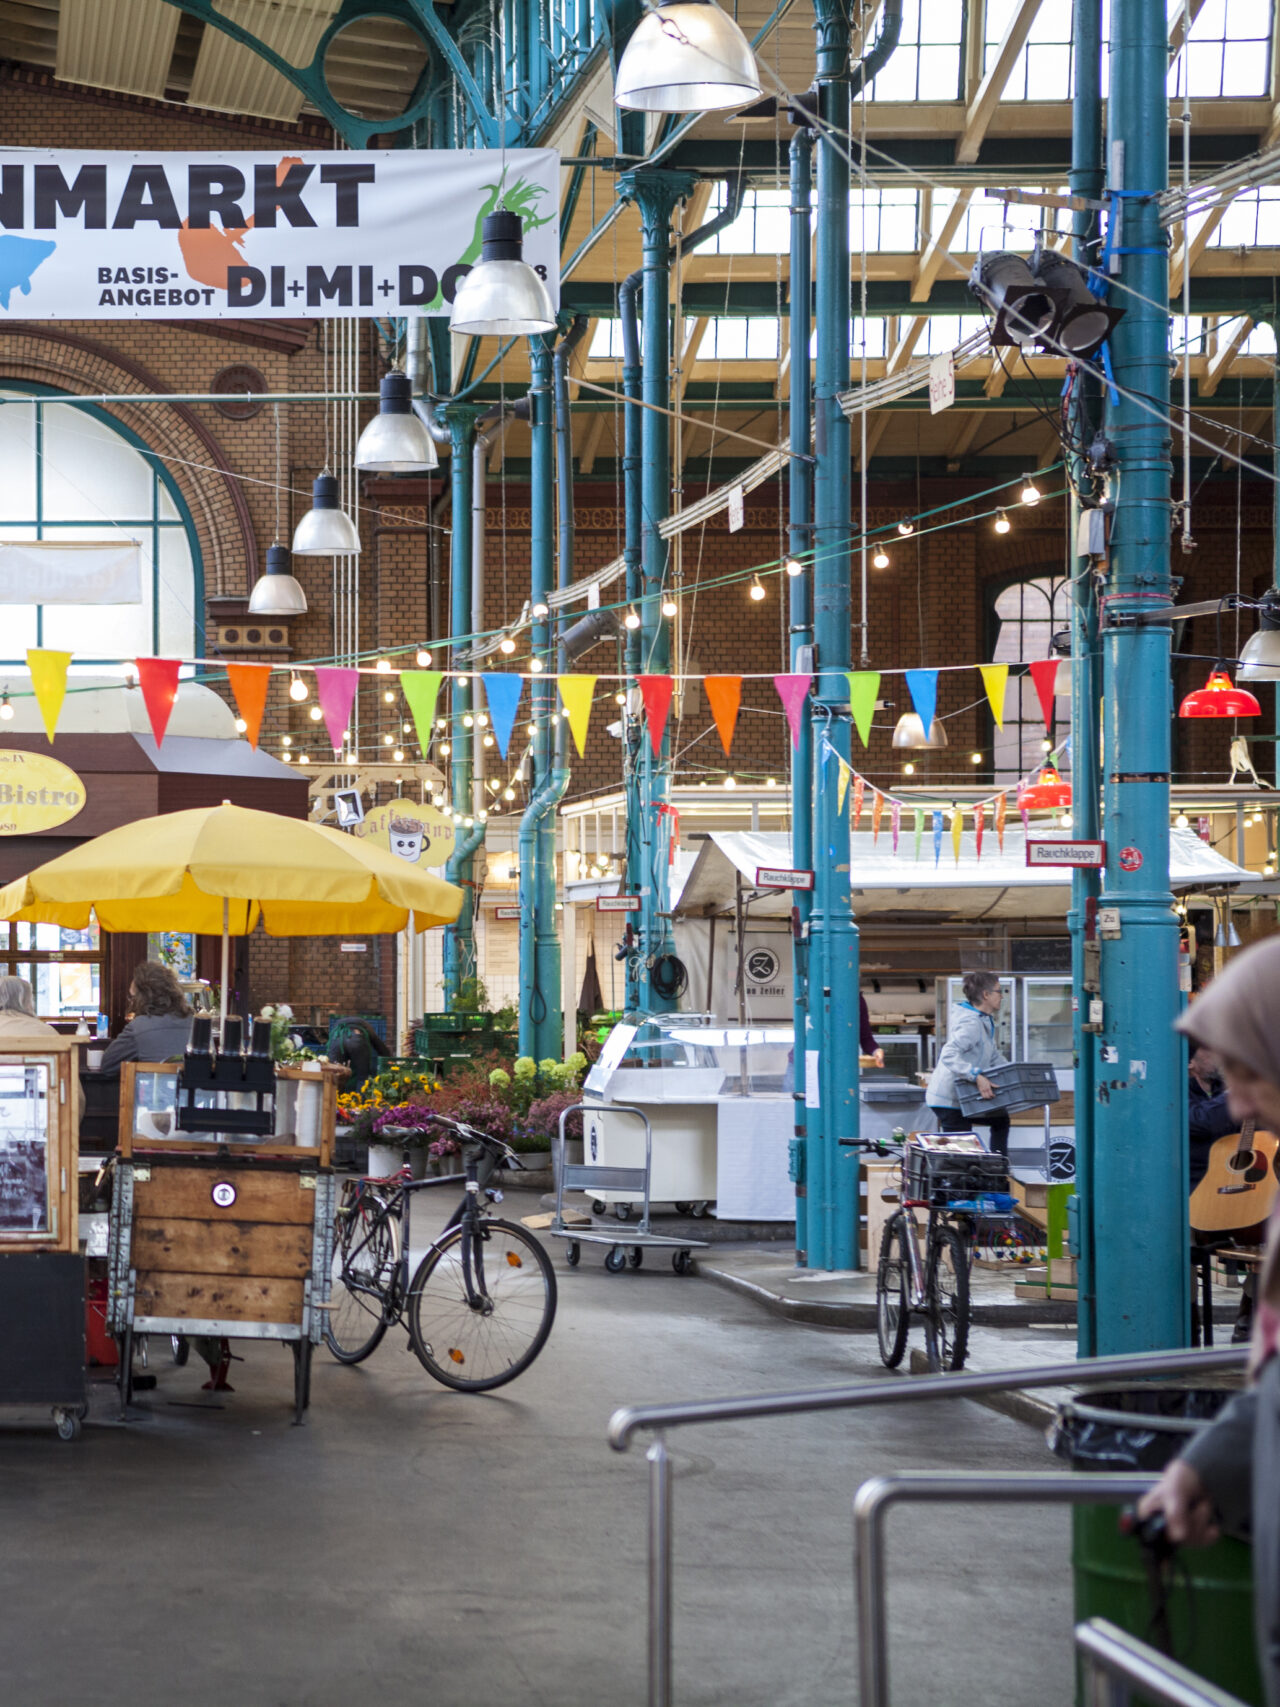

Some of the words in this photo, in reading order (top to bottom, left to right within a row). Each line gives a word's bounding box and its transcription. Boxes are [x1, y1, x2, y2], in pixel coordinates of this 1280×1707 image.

[97, 267, 179, 284] BASIS-
[98, 288, 216, 306] ANGEBOT
[13, 754, 24, 763] IX
[1037, 847, 1095, 860] Rauchklappe
[763, 872, 806, 885] Rauchklappe
